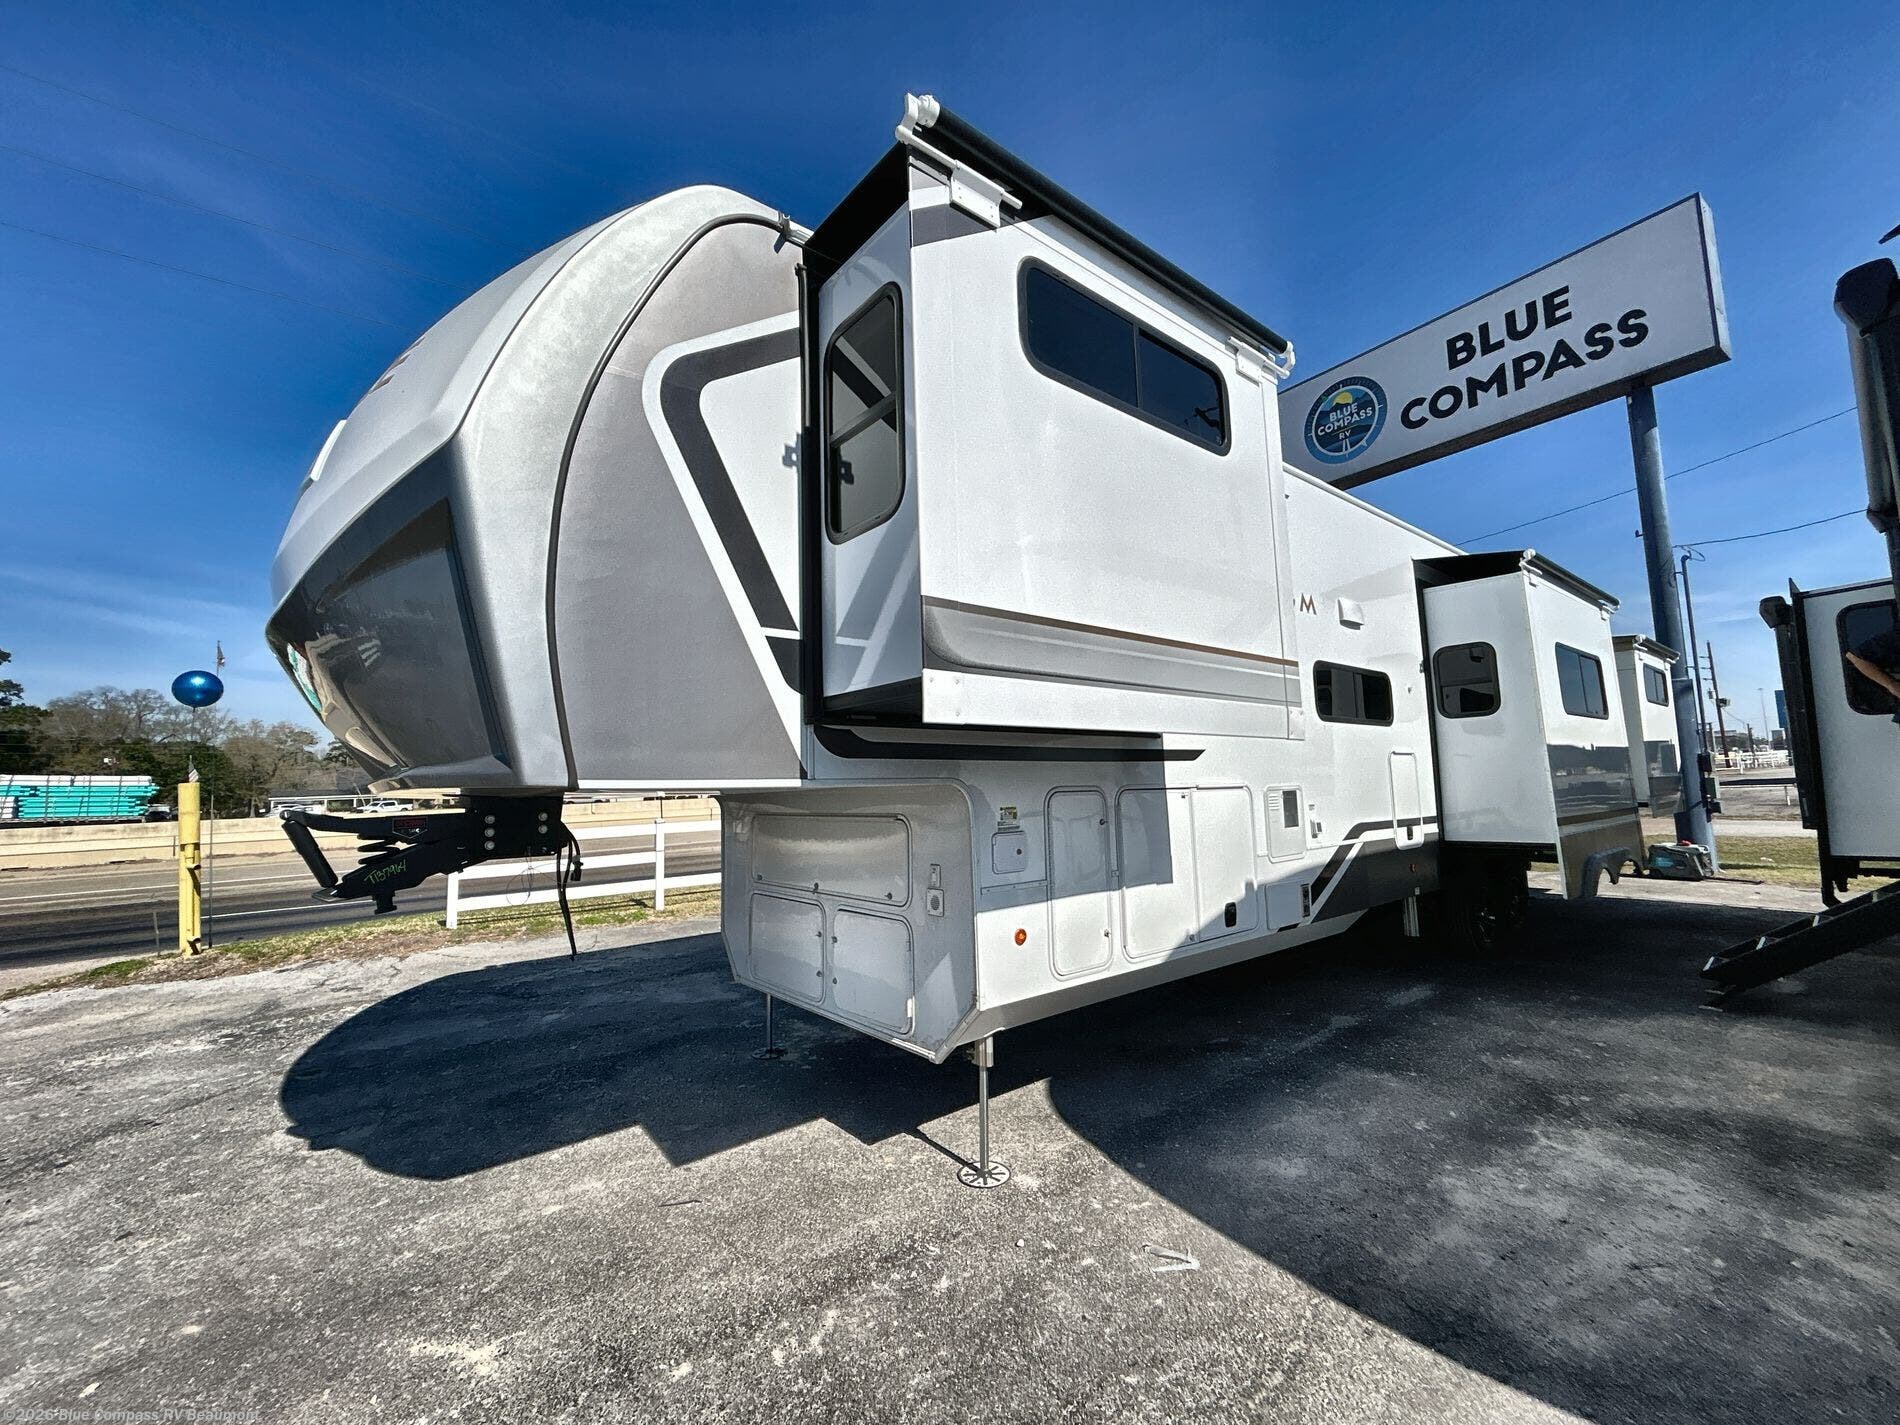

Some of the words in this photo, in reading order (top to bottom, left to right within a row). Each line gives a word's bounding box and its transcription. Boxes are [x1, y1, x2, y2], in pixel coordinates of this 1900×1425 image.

[1446, 285, 1573, 370] BLUE
[1400, 309, 1649, 429] COMPASS
[1317, 407, 1373, 436] COMPASS
[1329, 402, 1358, 422] BLUE
[1338, 429, 1352, 440] RV
